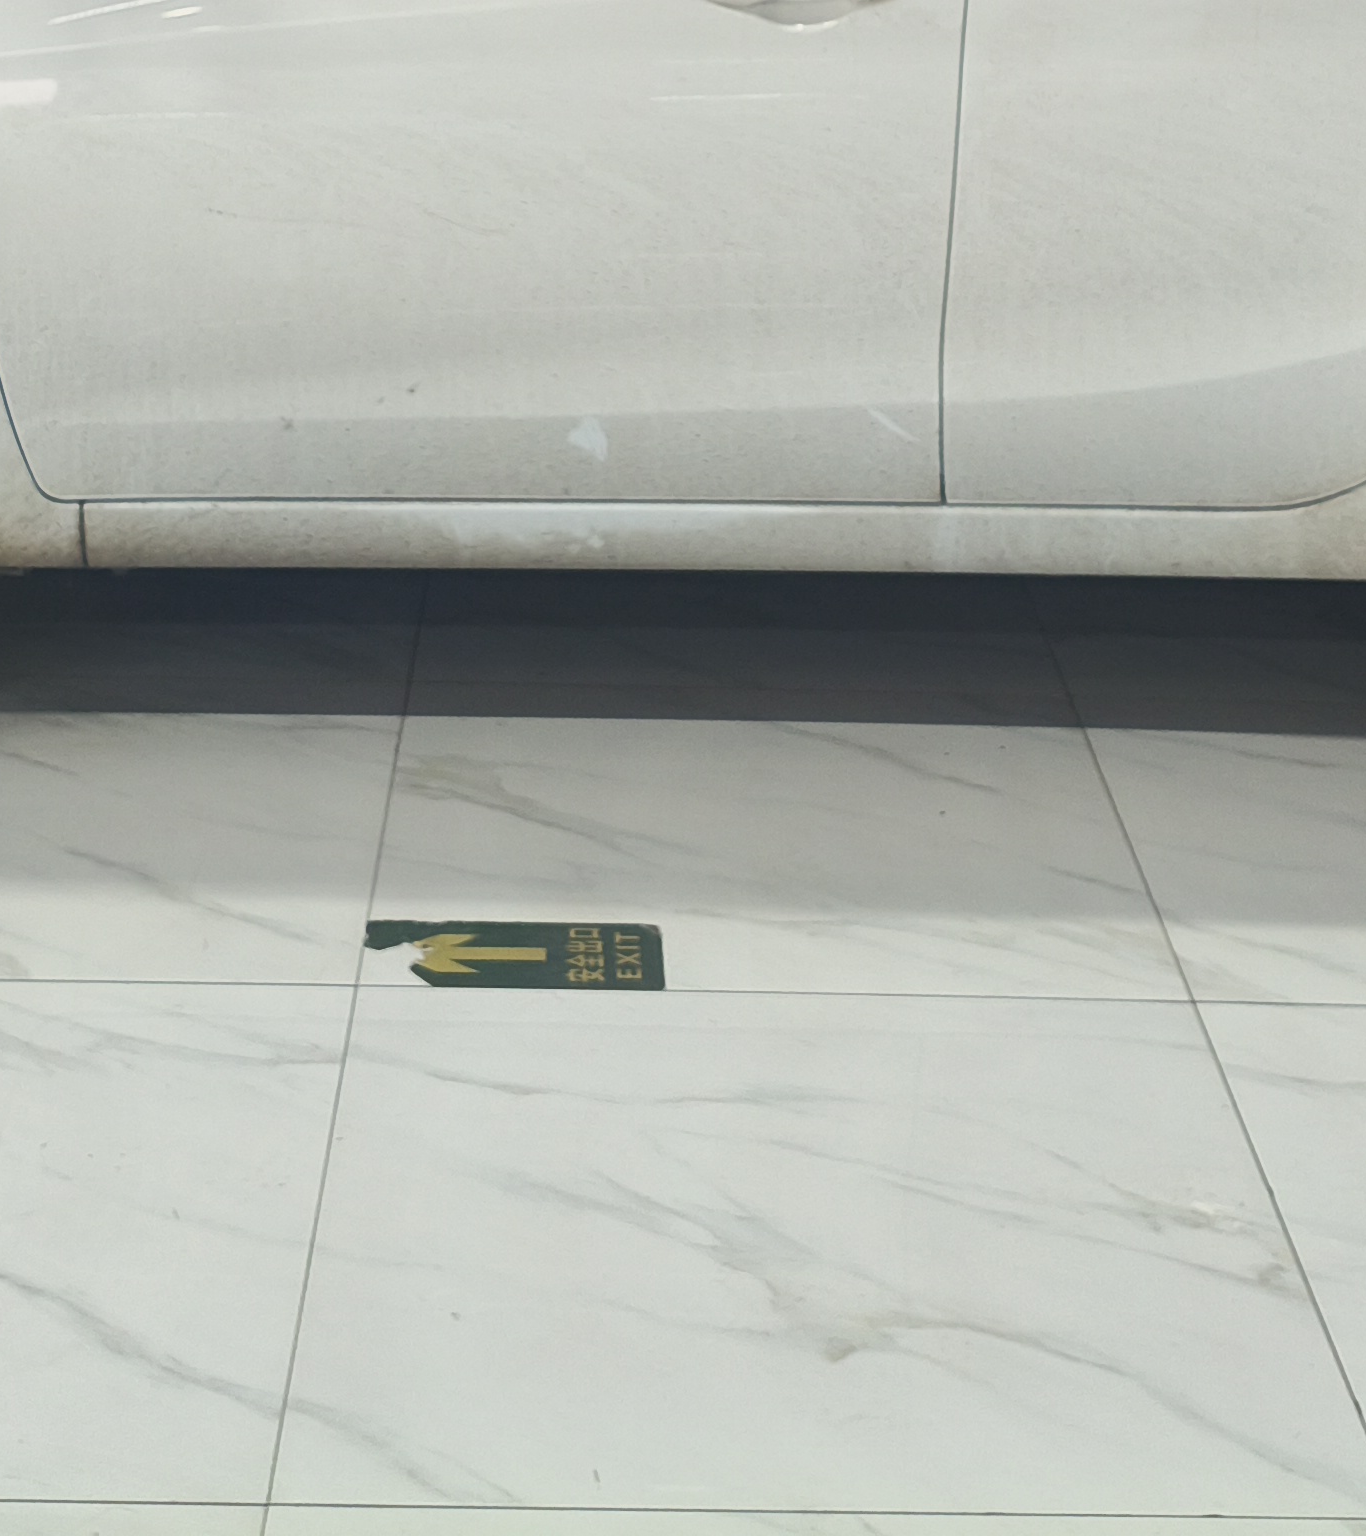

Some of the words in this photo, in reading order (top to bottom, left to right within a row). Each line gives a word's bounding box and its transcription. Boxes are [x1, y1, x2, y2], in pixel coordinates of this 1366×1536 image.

[565, 927, 606, 983] 安全出口
[615, 930, 643, 982] EXIT
